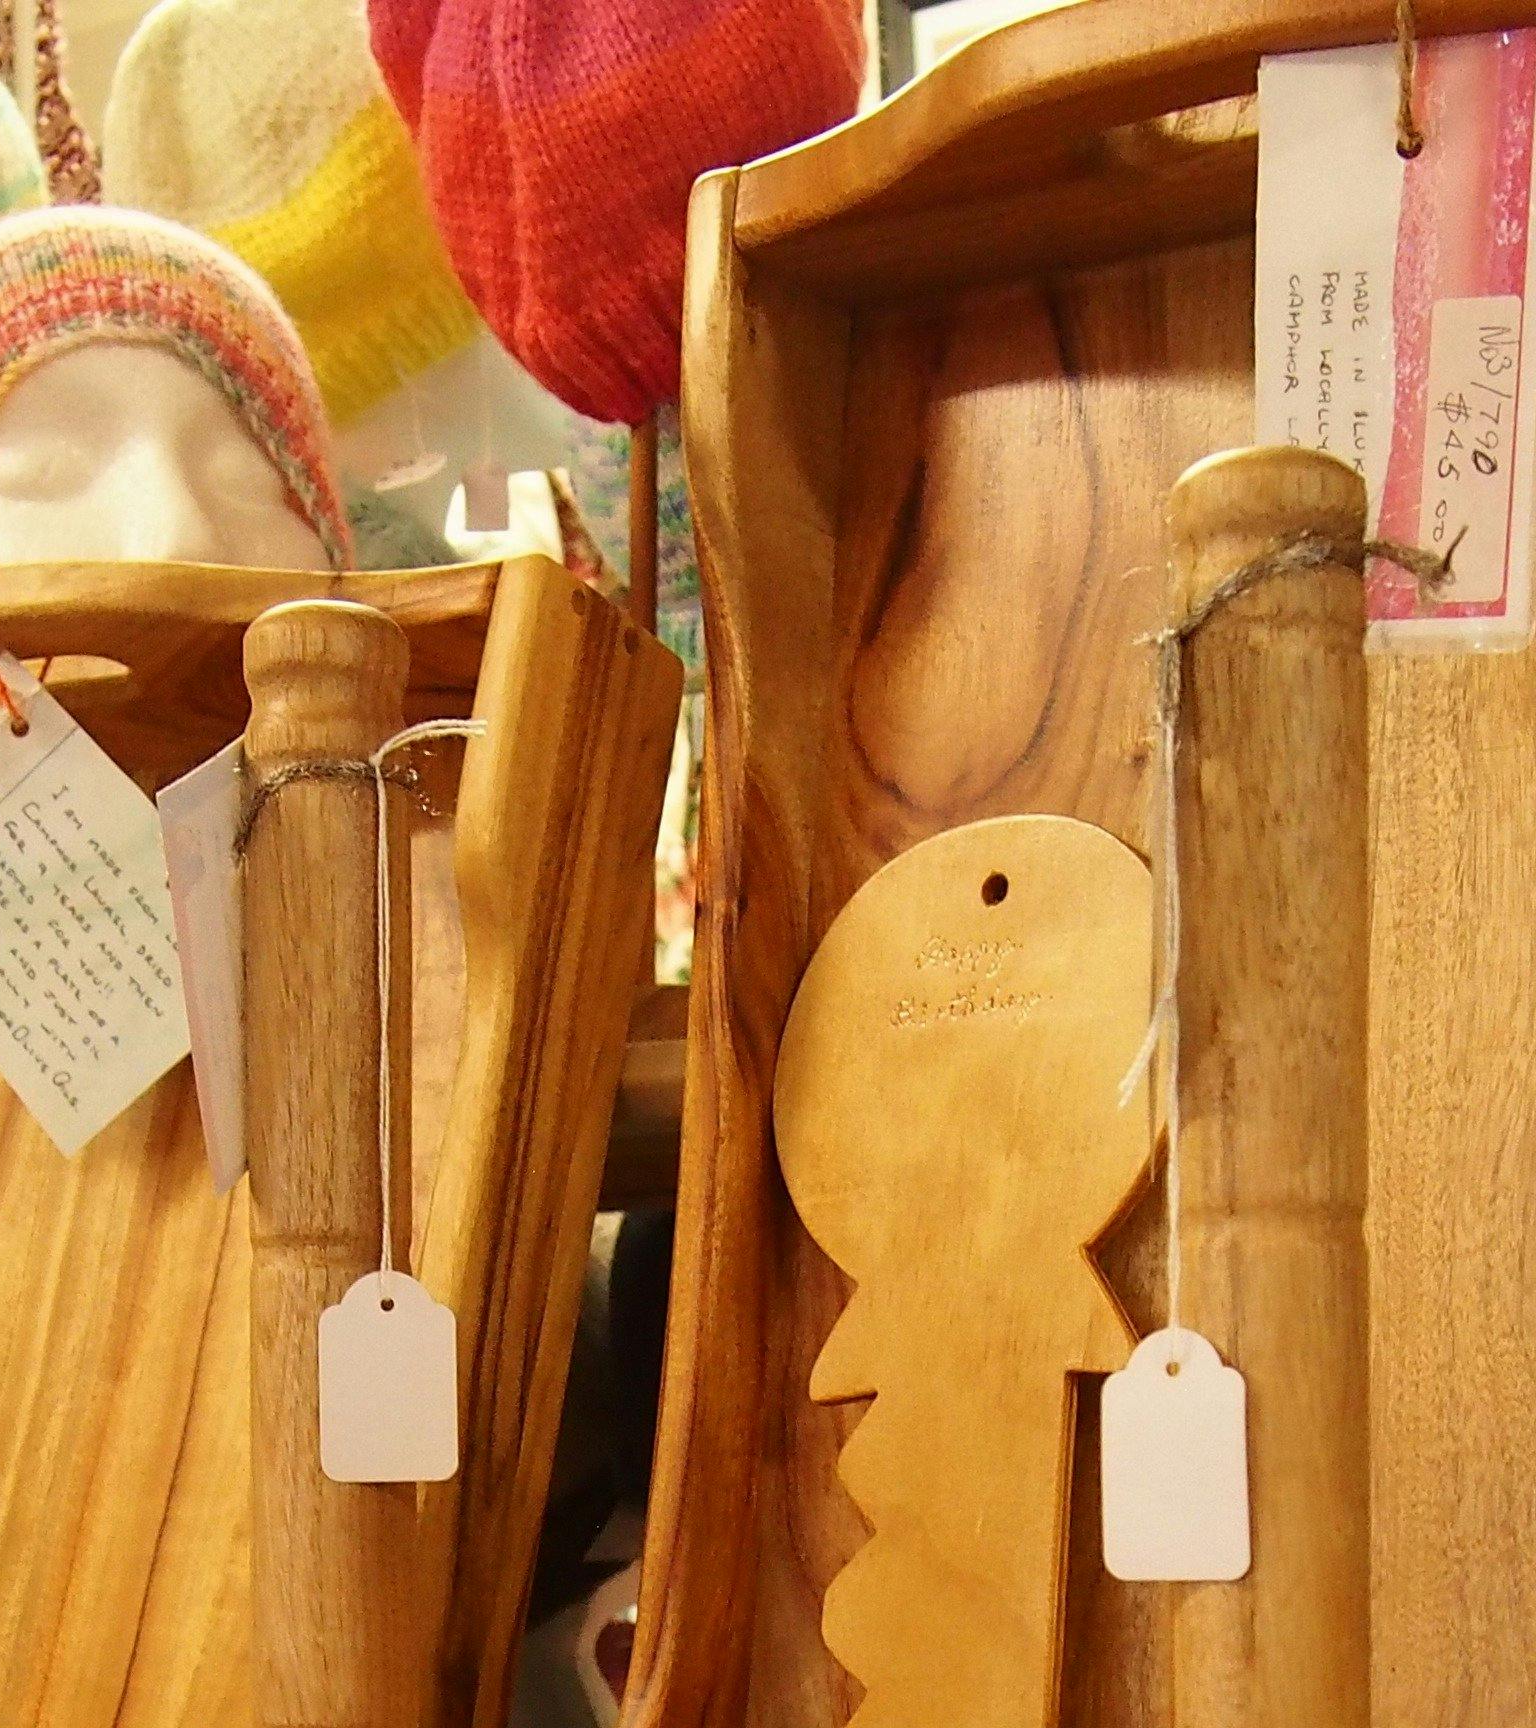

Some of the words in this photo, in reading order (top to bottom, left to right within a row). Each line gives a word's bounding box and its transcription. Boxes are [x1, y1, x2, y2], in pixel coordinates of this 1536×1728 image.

[1320, 270, 1341, 326] FROM
[1351, 270, 1371, 332] MADE
[1283, 273, 1305, 394] CAMPHOR
[1353, 356, 1366, 383] IN
[1350, 410, 1370, 474] ILUK
[1436, 391, 1472, 482] $45
